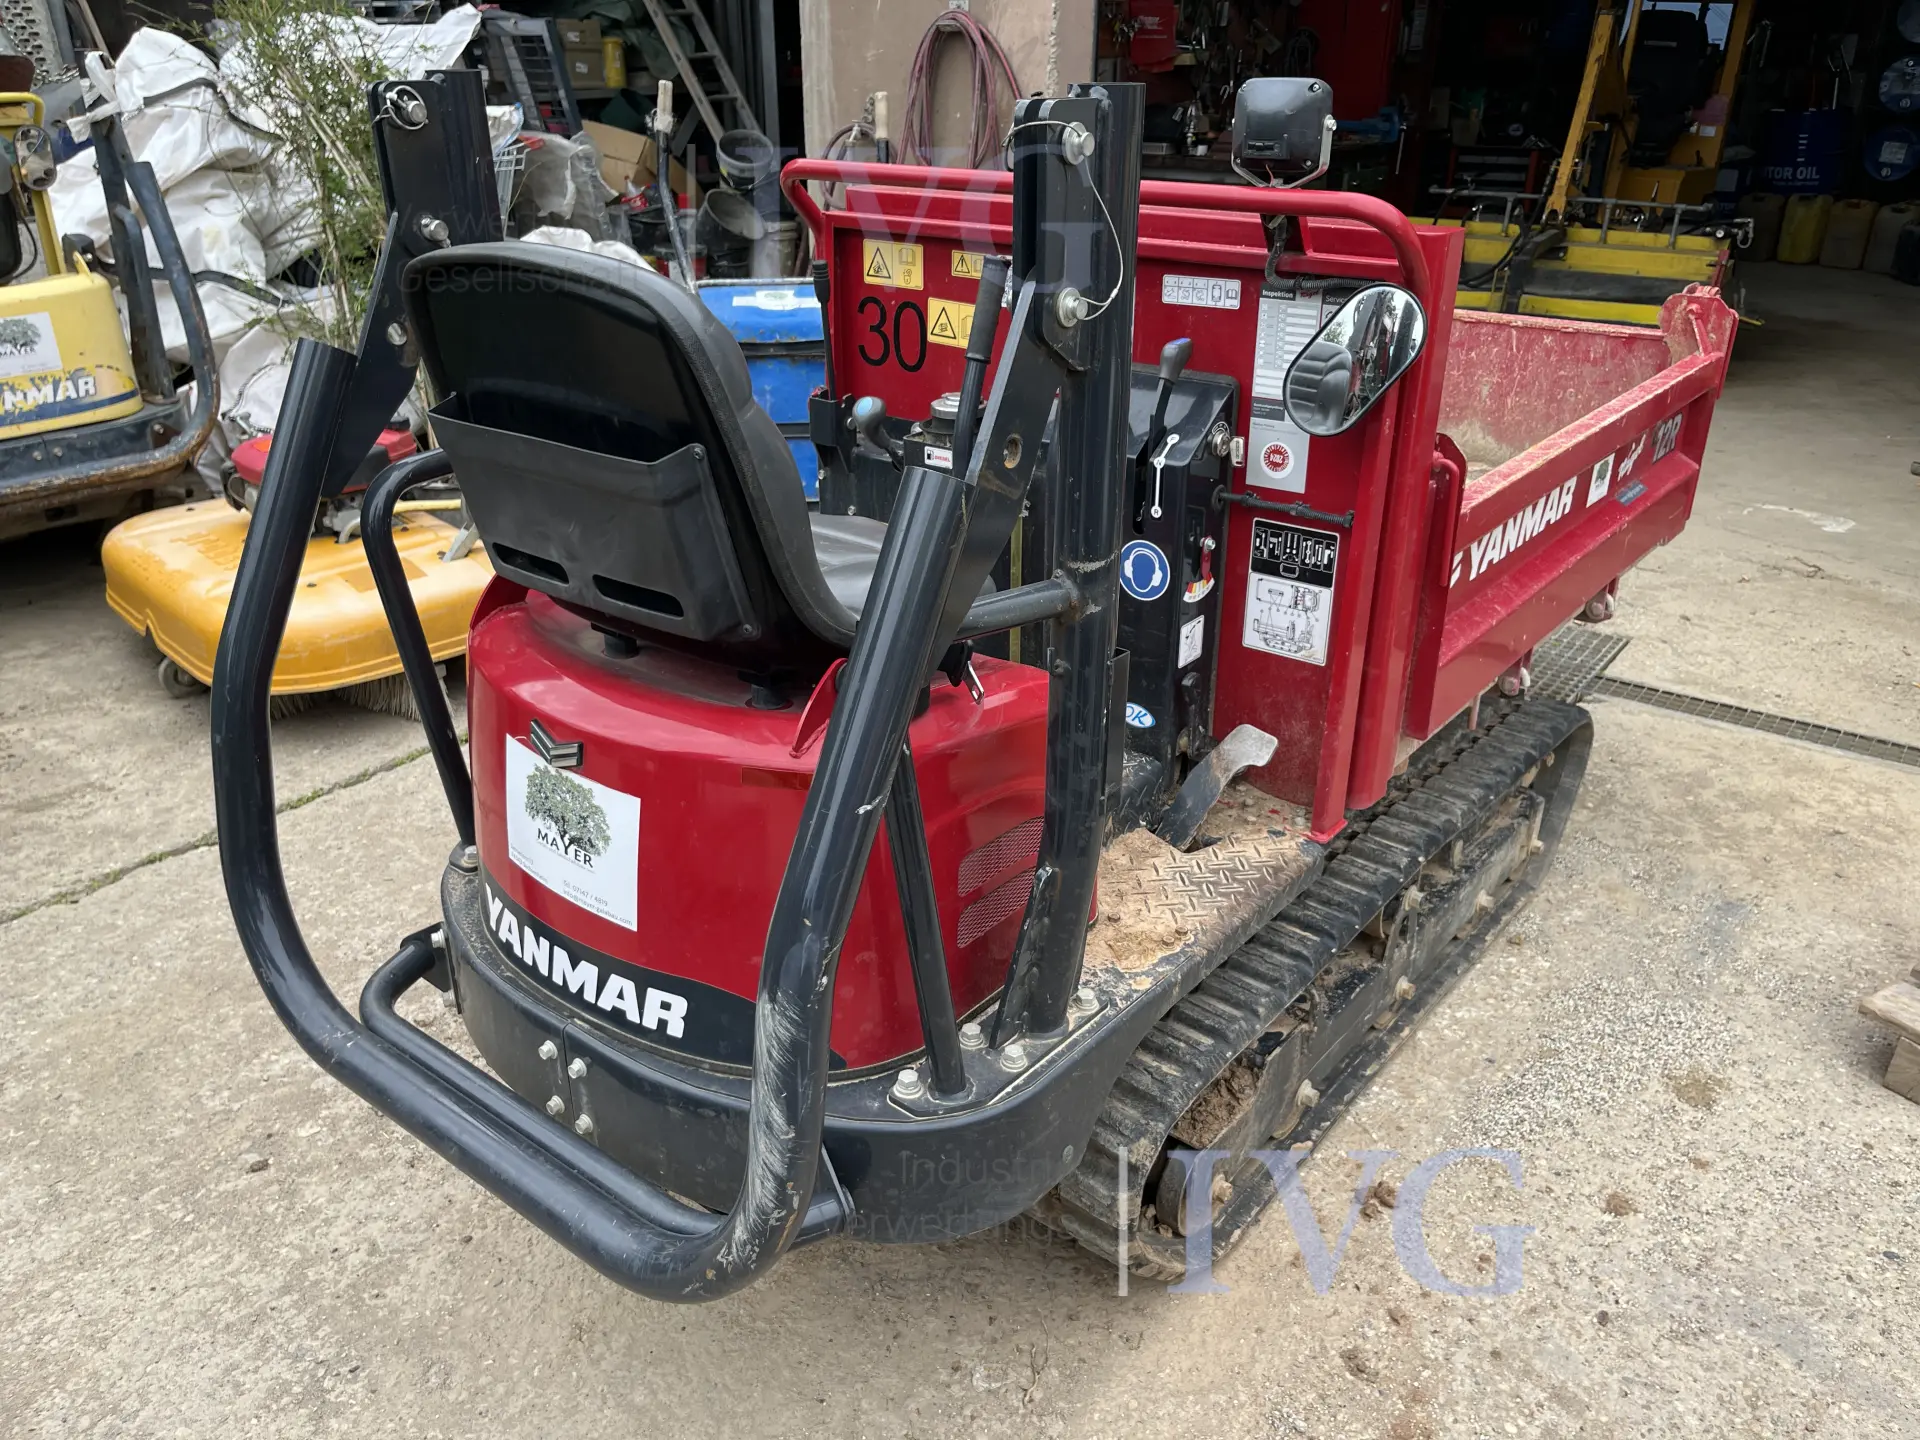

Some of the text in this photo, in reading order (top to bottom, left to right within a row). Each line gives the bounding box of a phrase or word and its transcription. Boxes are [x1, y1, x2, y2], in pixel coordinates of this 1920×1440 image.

[1796, 166, 1820, 179] OIL
[1262, 289, 1294, 299] Inspektion
[857, 296, 928, 372] 30
[1469, 476, 1577, 581] YANMAR
[537, 828, 594, 868] MAYER
[485, 882, 689, 1039] YANMAR
